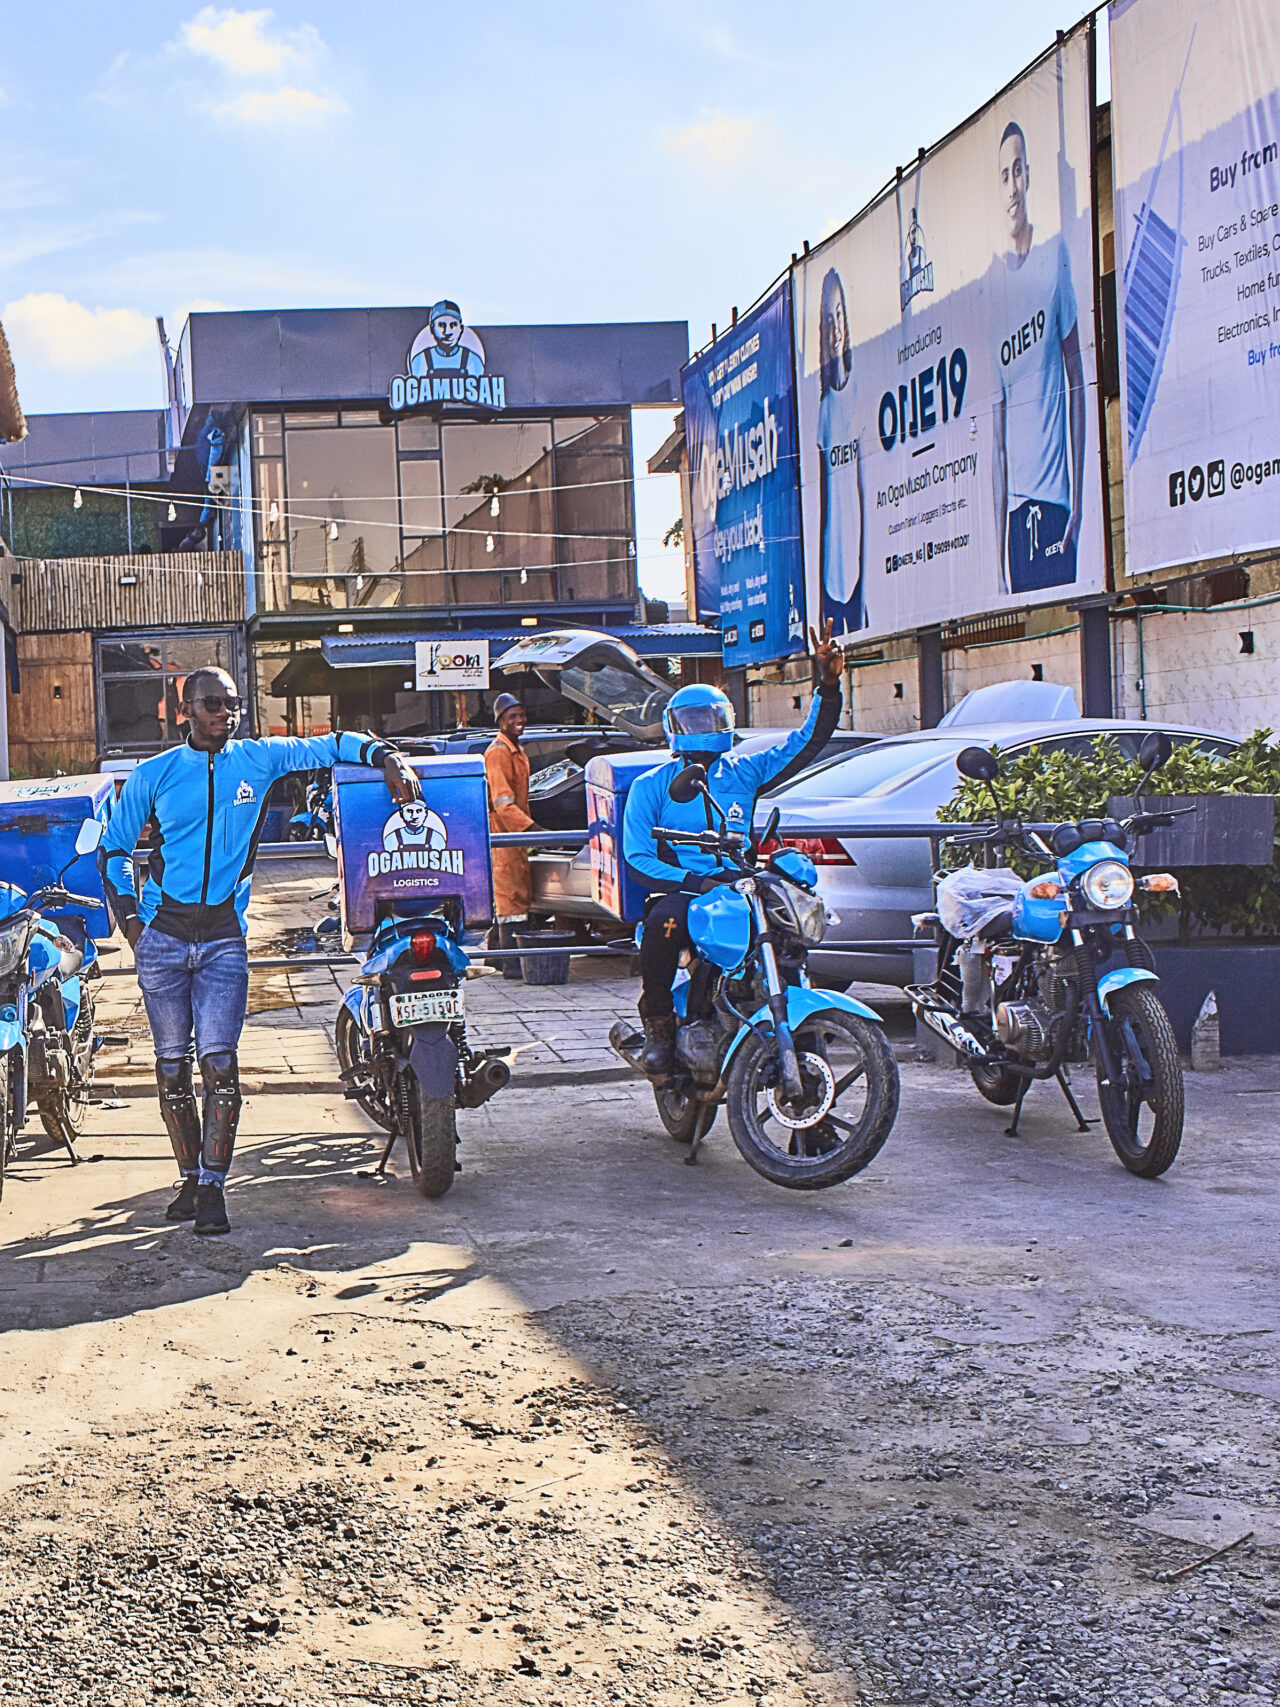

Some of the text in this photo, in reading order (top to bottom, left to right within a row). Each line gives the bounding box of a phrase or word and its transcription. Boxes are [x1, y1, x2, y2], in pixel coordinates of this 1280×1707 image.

[1210, 142, 1278, 192] Buy from
[1198, 203, 1279, 252] Buy Cars & Spare
[1201, 243, 1270, 282] Trucks, Textiles,
[1237, 280, 1265, 301] Home
[1218, 313, 1271, 343] Electronics,
[897, 326, 942, 365] Introducing
[1248, 349, 1267, 366] Buy
[391, 376, 506, 411] OGAMUSAH
[700, 397, 778, 522] OgaMusah
[877, 491, 887, 509] An
[932, 452, 978, 484] Company
[368, 850, 464, 878] OGAMUSAH
[393, 878, 439, 888] LOGISTICS
[397, 1000, 459, 1019] KSF-515QC
[414, 991, 451, 999] LAGOS
